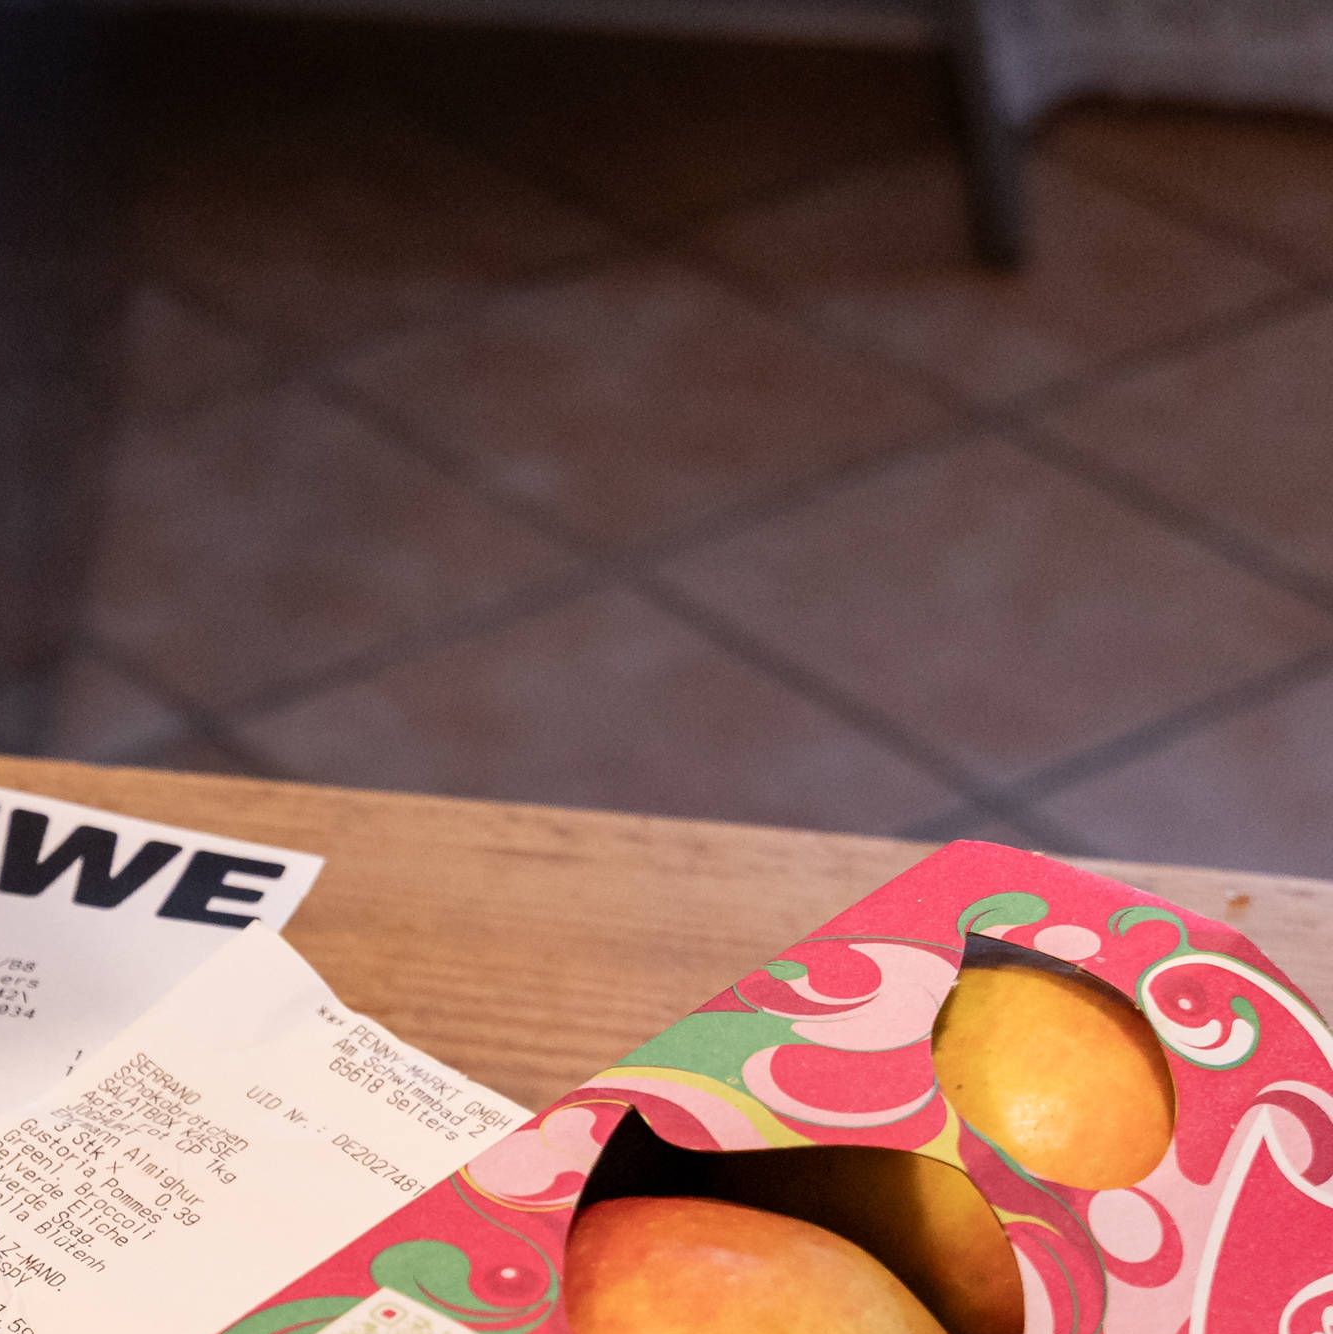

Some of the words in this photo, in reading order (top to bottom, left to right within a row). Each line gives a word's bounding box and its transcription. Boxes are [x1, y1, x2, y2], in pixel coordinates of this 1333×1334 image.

[329, 1056, 385, 1094] 65618
[386, 1089, 459, 1141] Selters
[20, 1118, 96, 1178] Gustoria
[100, 1177, 162, 1224] Pommes
[74, 1182, 156, 1240] Broccoli
